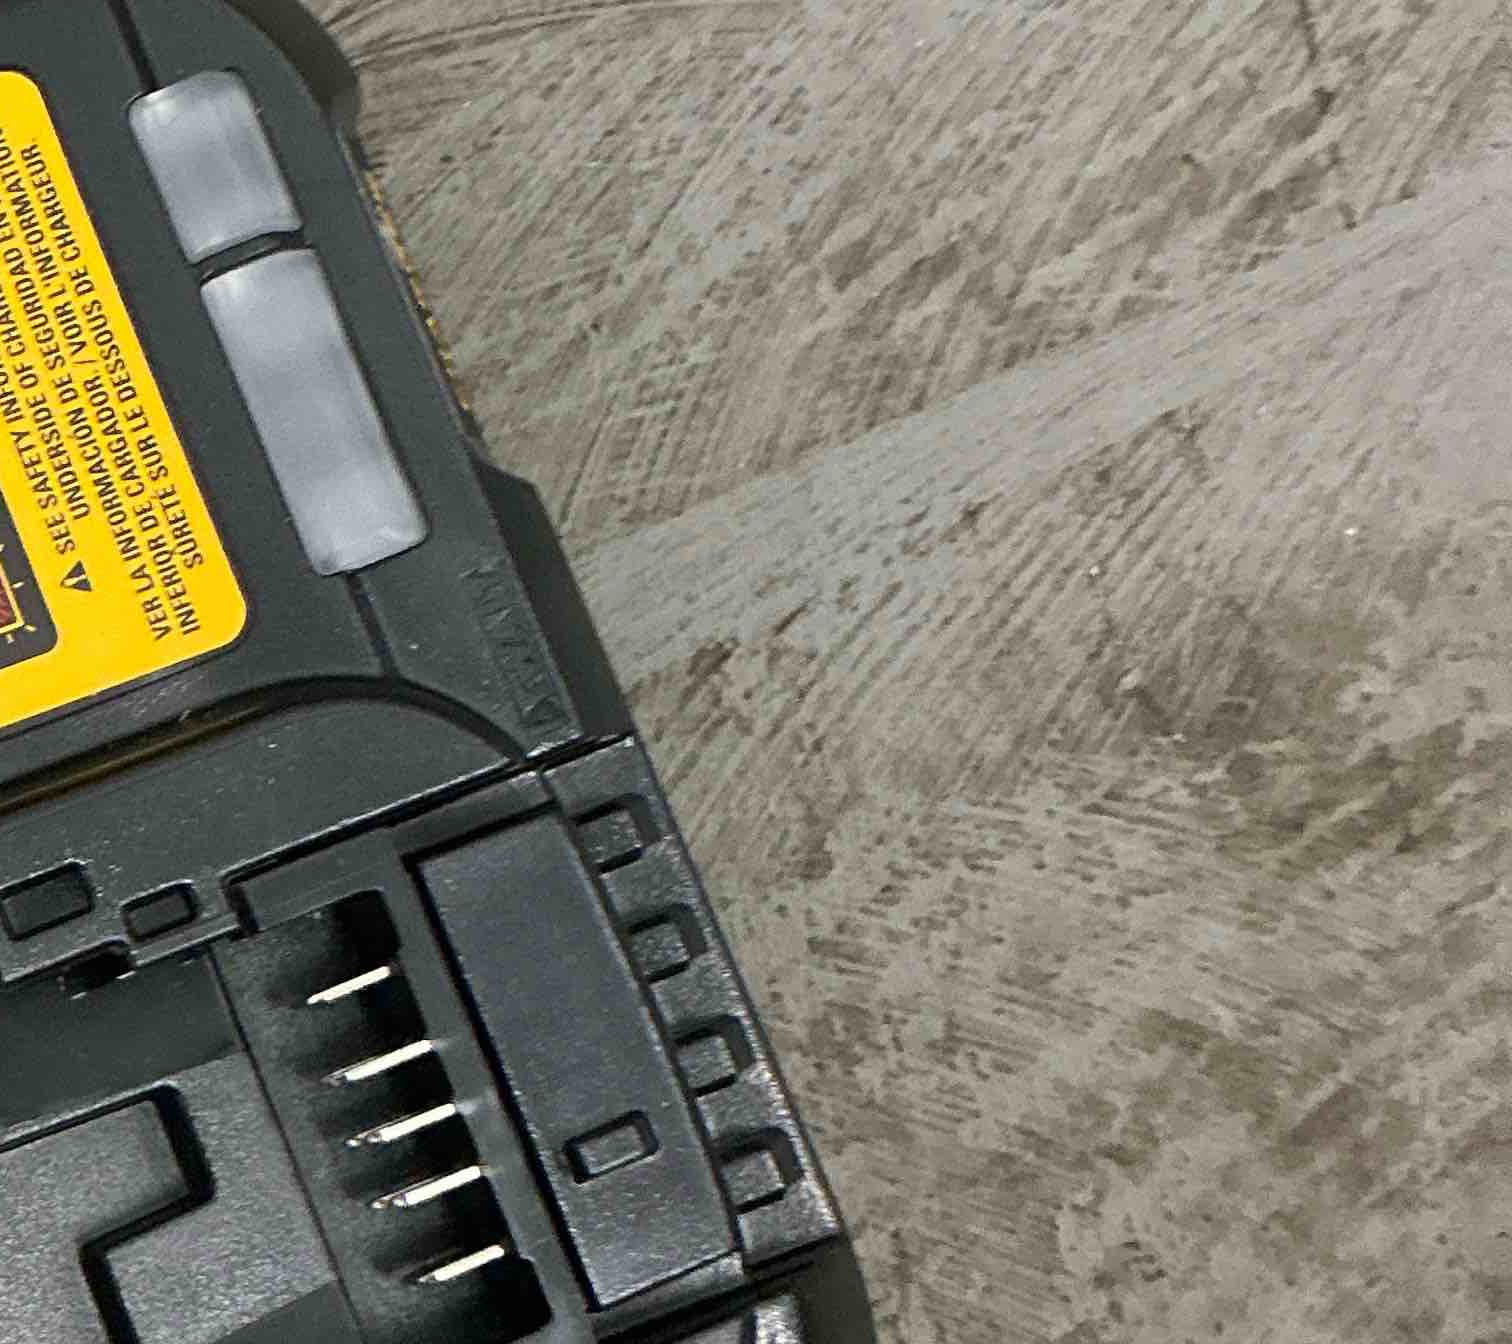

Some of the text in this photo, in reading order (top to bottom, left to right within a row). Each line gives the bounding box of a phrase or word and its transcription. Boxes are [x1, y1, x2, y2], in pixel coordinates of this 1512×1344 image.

[68, 265, 95, 297] DE
[2, 247, 66, 371] SEGURIDAD
[52, 300, 88, 357] VOIR
[81, 299, 138, 404] DESSOUS
[13, 362, 39, 390] OF
[51, 373, 80, 405] DE
[123, 405, 150, 433] LE
[9, 430, 59, 510] SAFETY
[25, 392, 91, 521] UNDERSIDE
[136, 434, 169, 482] SUR
[65, 407, 143, 562] INFORMACIÓN
[44, 512, 76, 556] SEE
[132, 500, 160, 533] DE
[129, 563, 155, 594] LA
[146, 533, 201, 636] INFERIOR
[141, 595, 173, 641] VER
